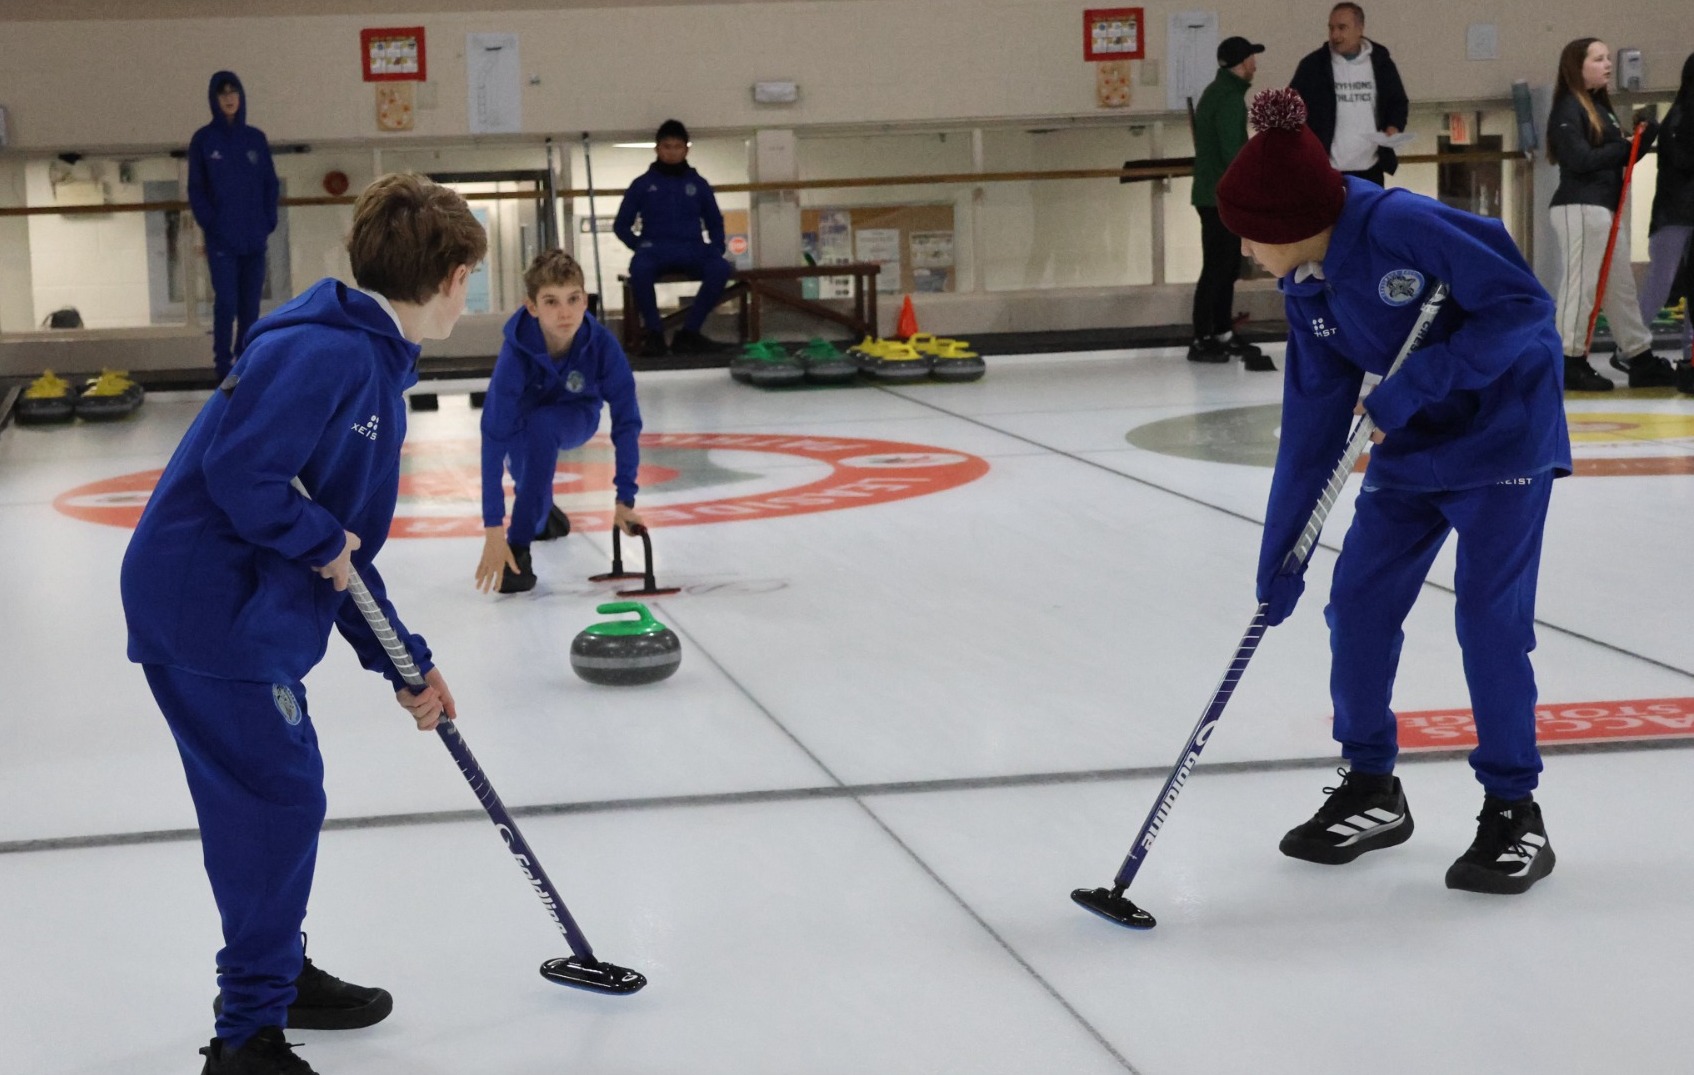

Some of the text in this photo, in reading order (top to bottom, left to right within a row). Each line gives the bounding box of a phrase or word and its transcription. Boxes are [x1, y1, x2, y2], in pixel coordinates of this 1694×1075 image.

[351, 422, 378, 441] XEIS
[1404, 703, 1682, 728] STOGE
[1421, 713, 1694, 740] ACCS
